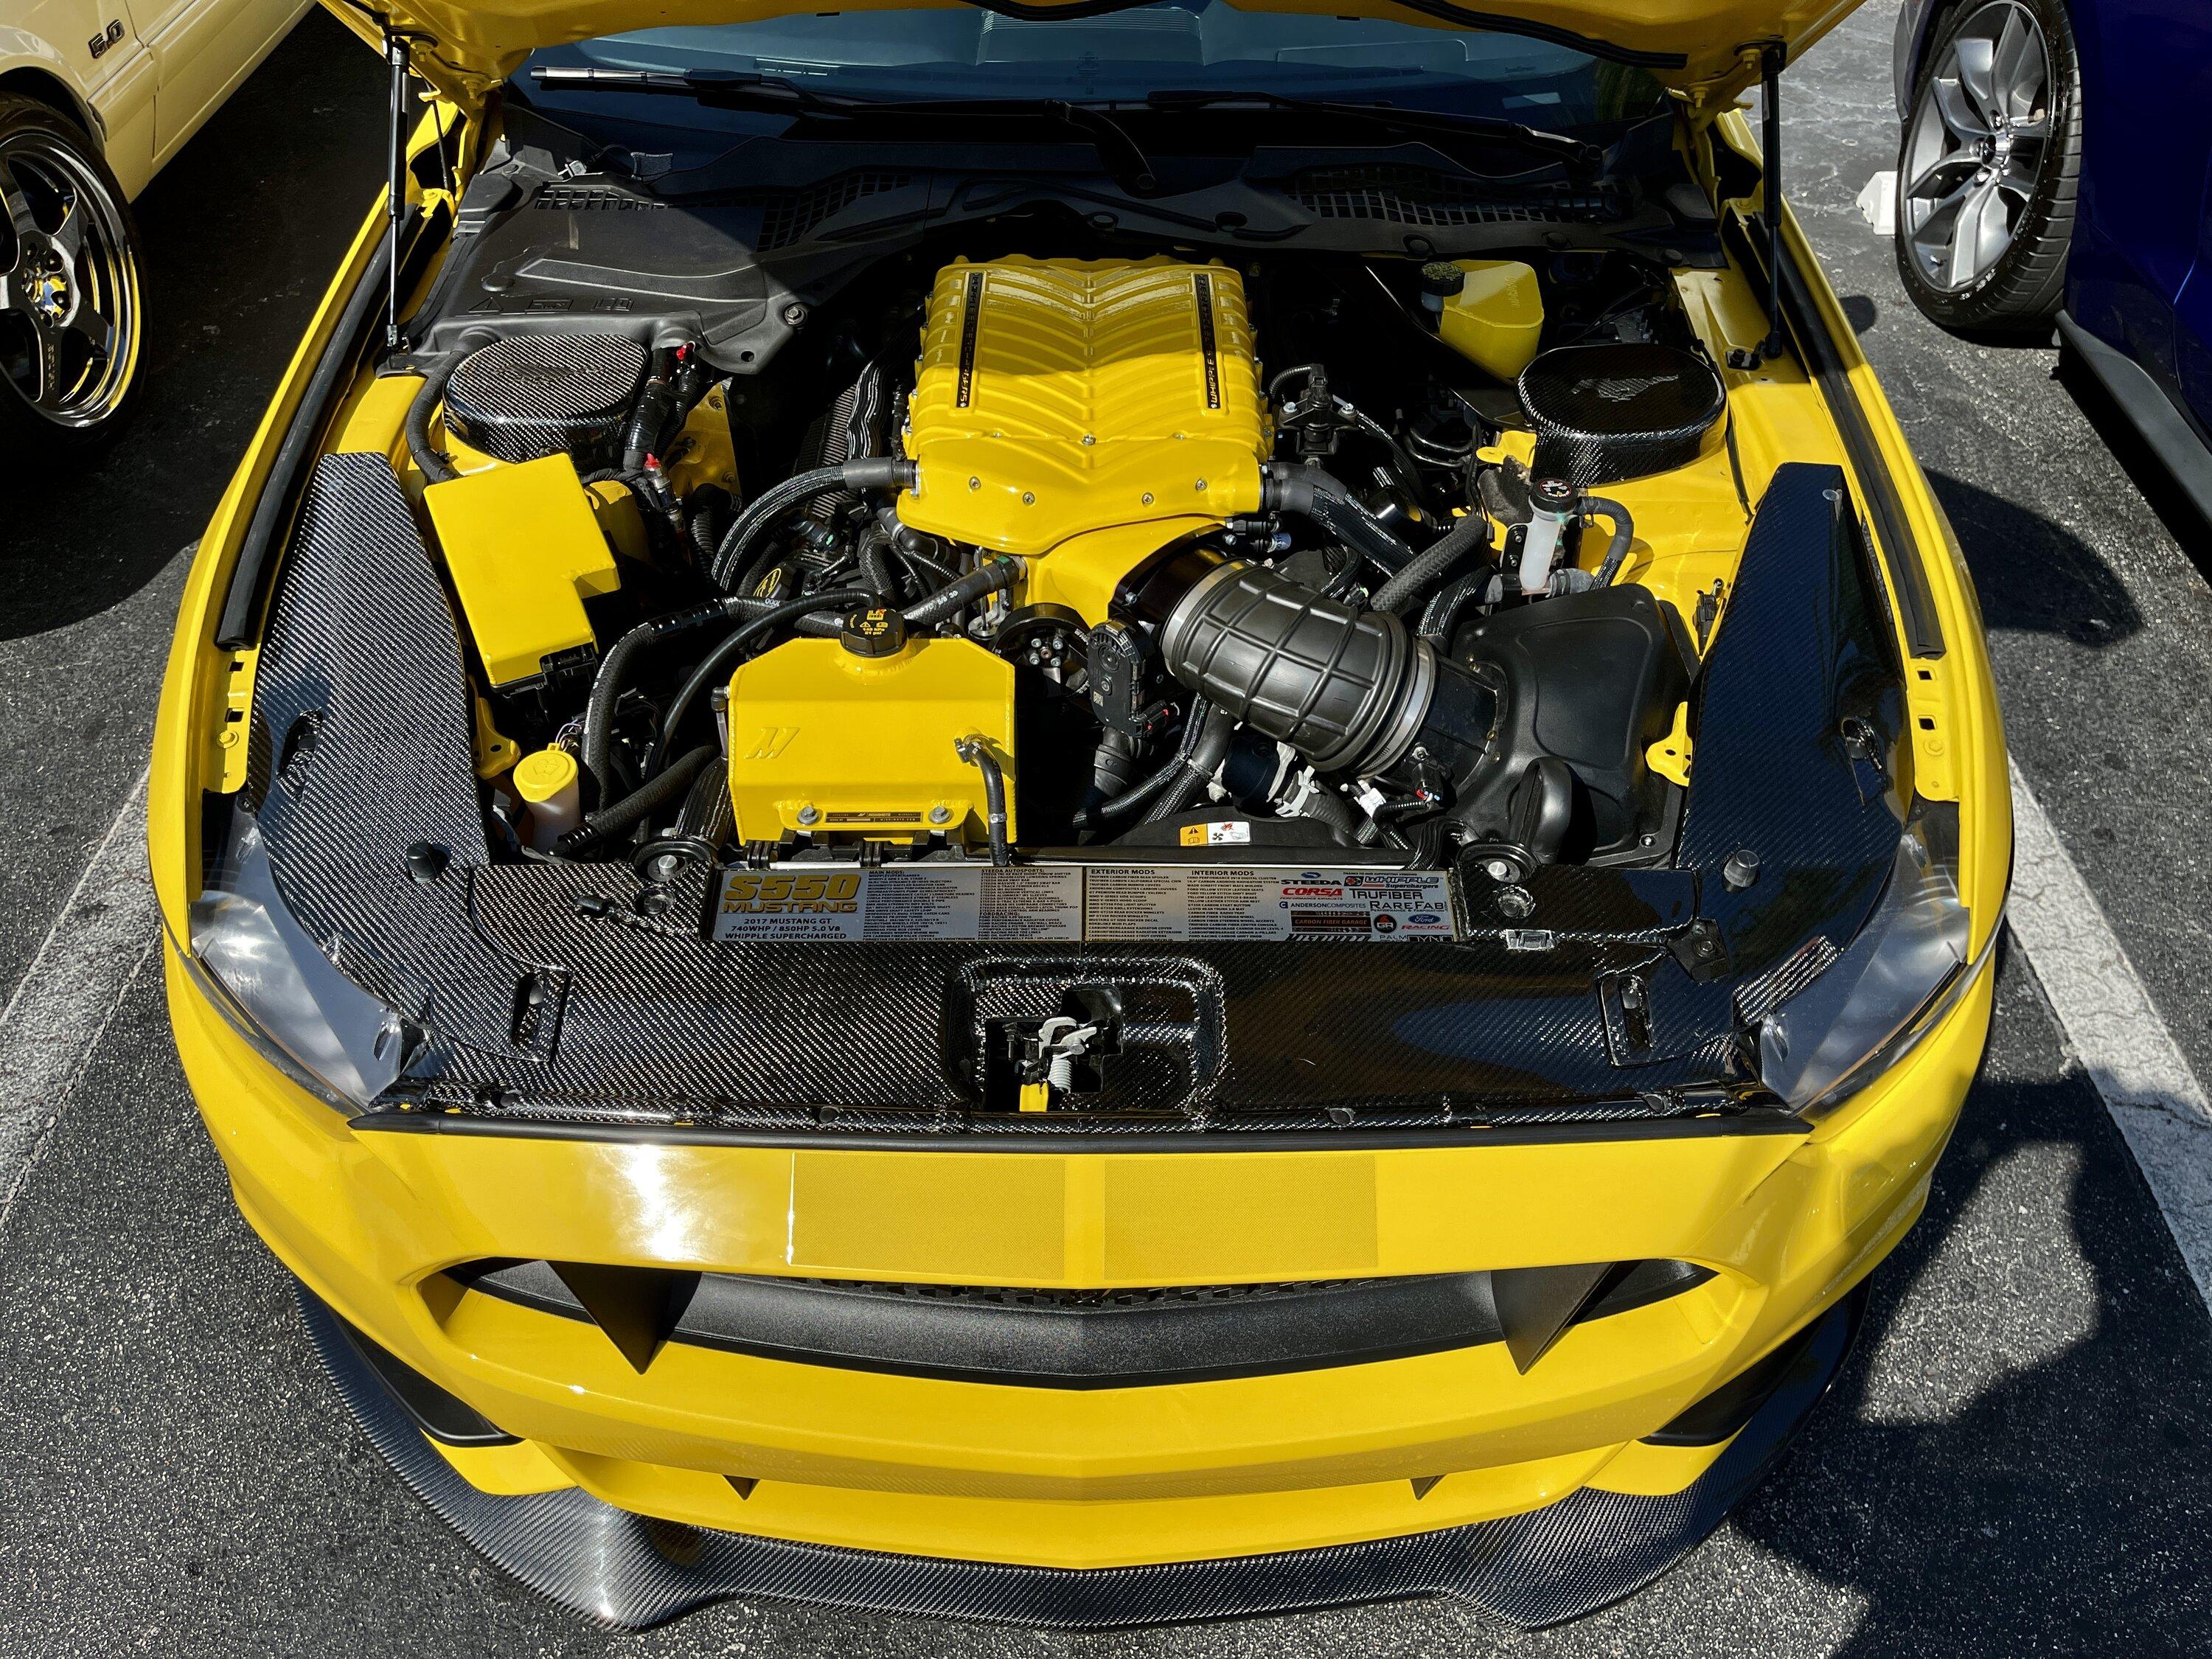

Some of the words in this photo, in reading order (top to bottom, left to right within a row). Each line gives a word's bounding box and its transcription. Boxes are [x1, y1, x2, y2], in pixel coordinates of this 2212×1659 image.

[88, 19, 125, 59] 5.0
[1206, 358, 1218, 403] WHIPPLE
[1364, 876, 1439, 884] WHIPPLE
[724, 874, 861, 901] S550
[1283, 887, 1343, 897] CORSA
[1349, 888, 1423, 900] TRUFIBER
[723, 901, 858, 914] MUSTANG
